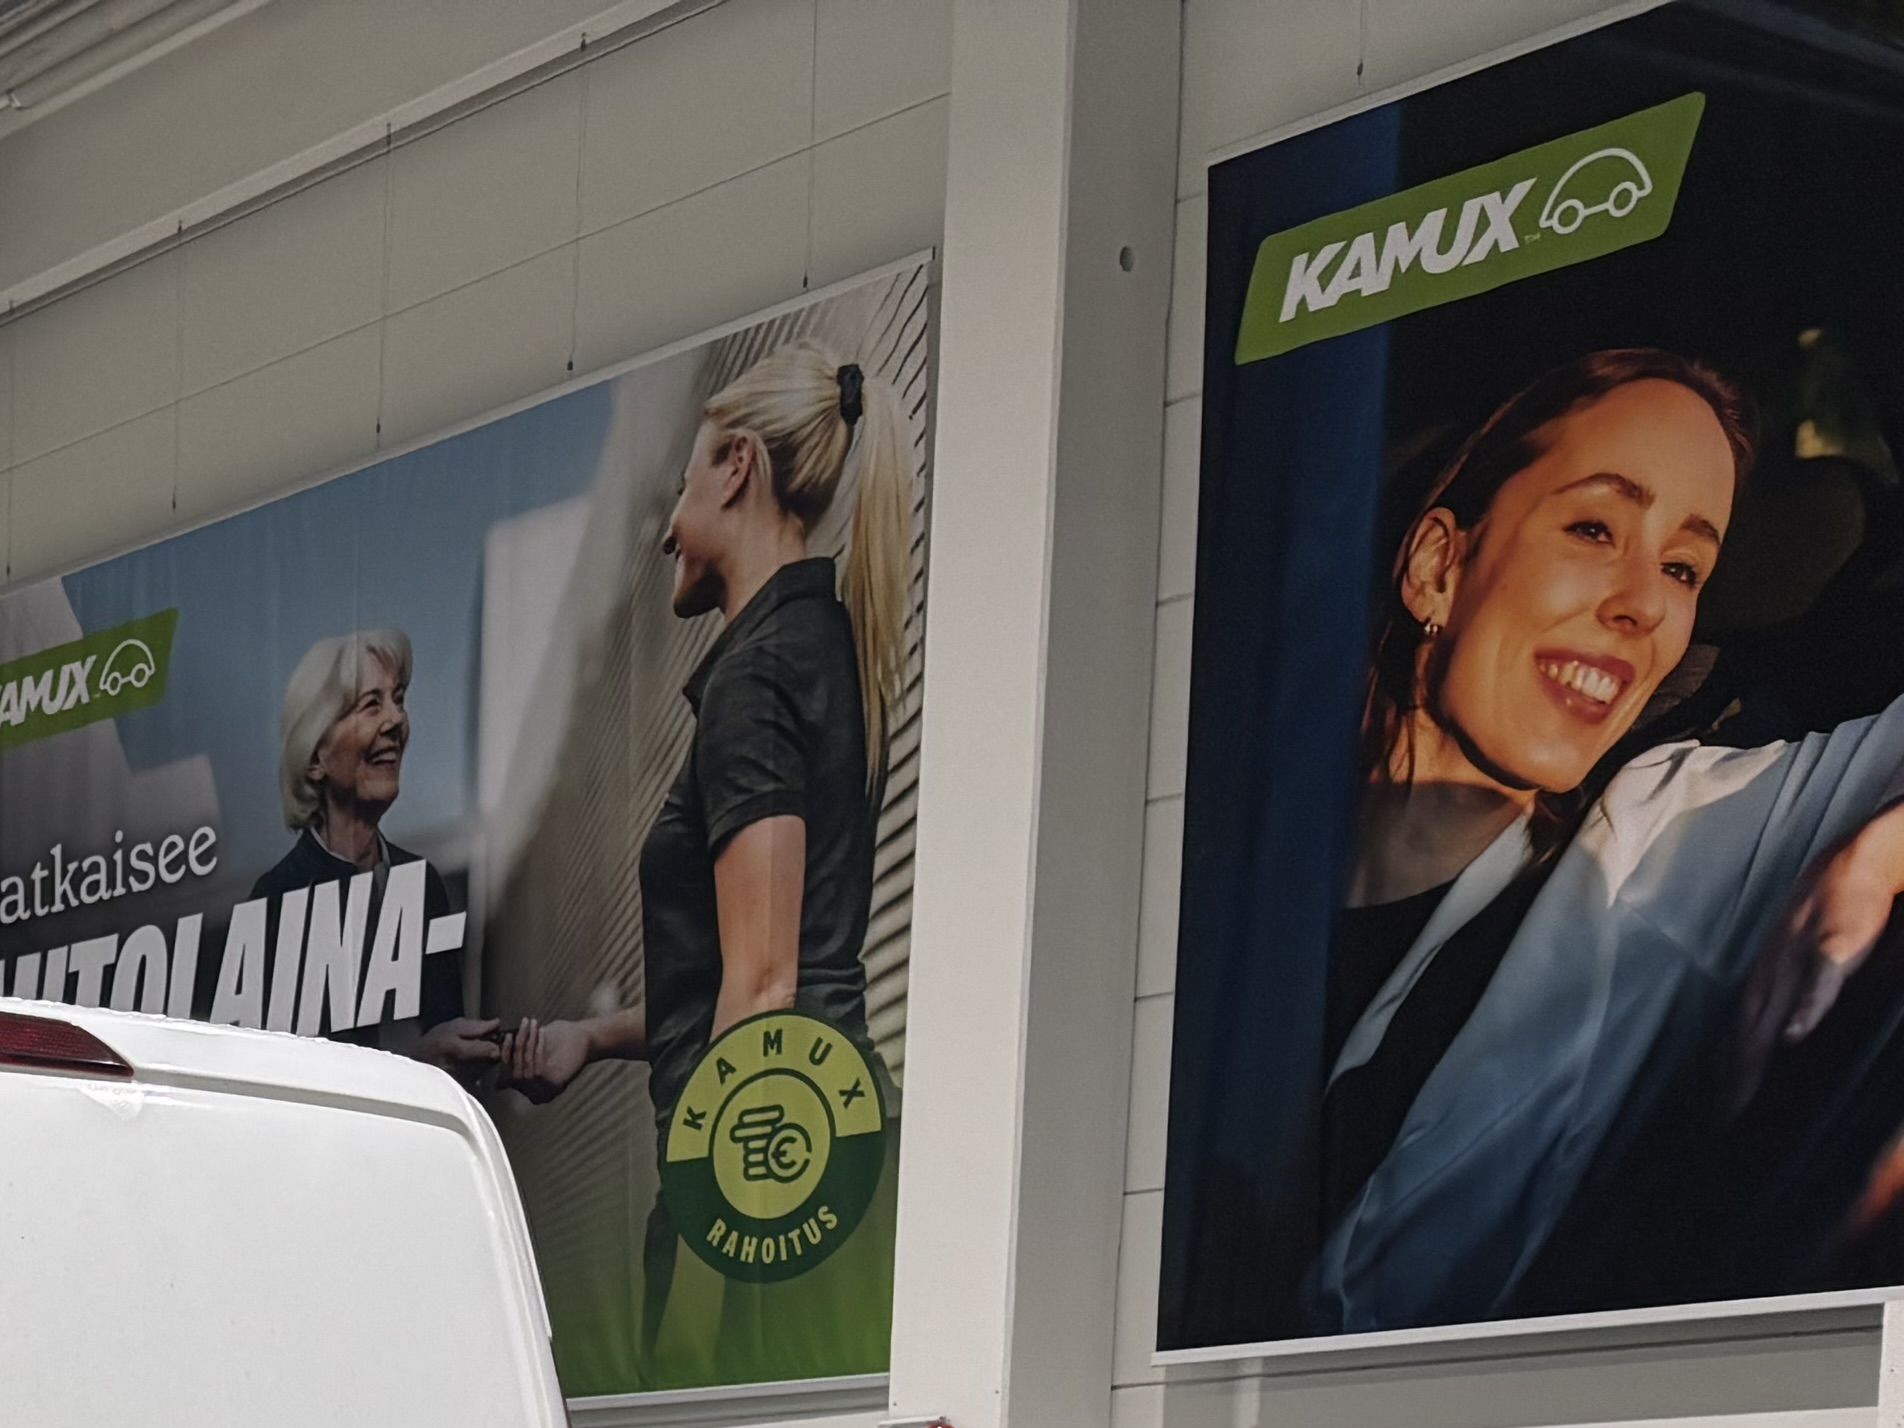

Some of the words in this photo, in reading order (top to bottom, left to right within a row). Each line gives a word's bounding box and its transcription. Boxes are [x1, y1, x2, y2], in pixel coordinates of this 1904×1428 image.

[1279, 177, 1538, 323] KAMUX
[682, 1028, 866, 1133] KAMUX
[706, 1205, 839, 1265] RAHOITUS
